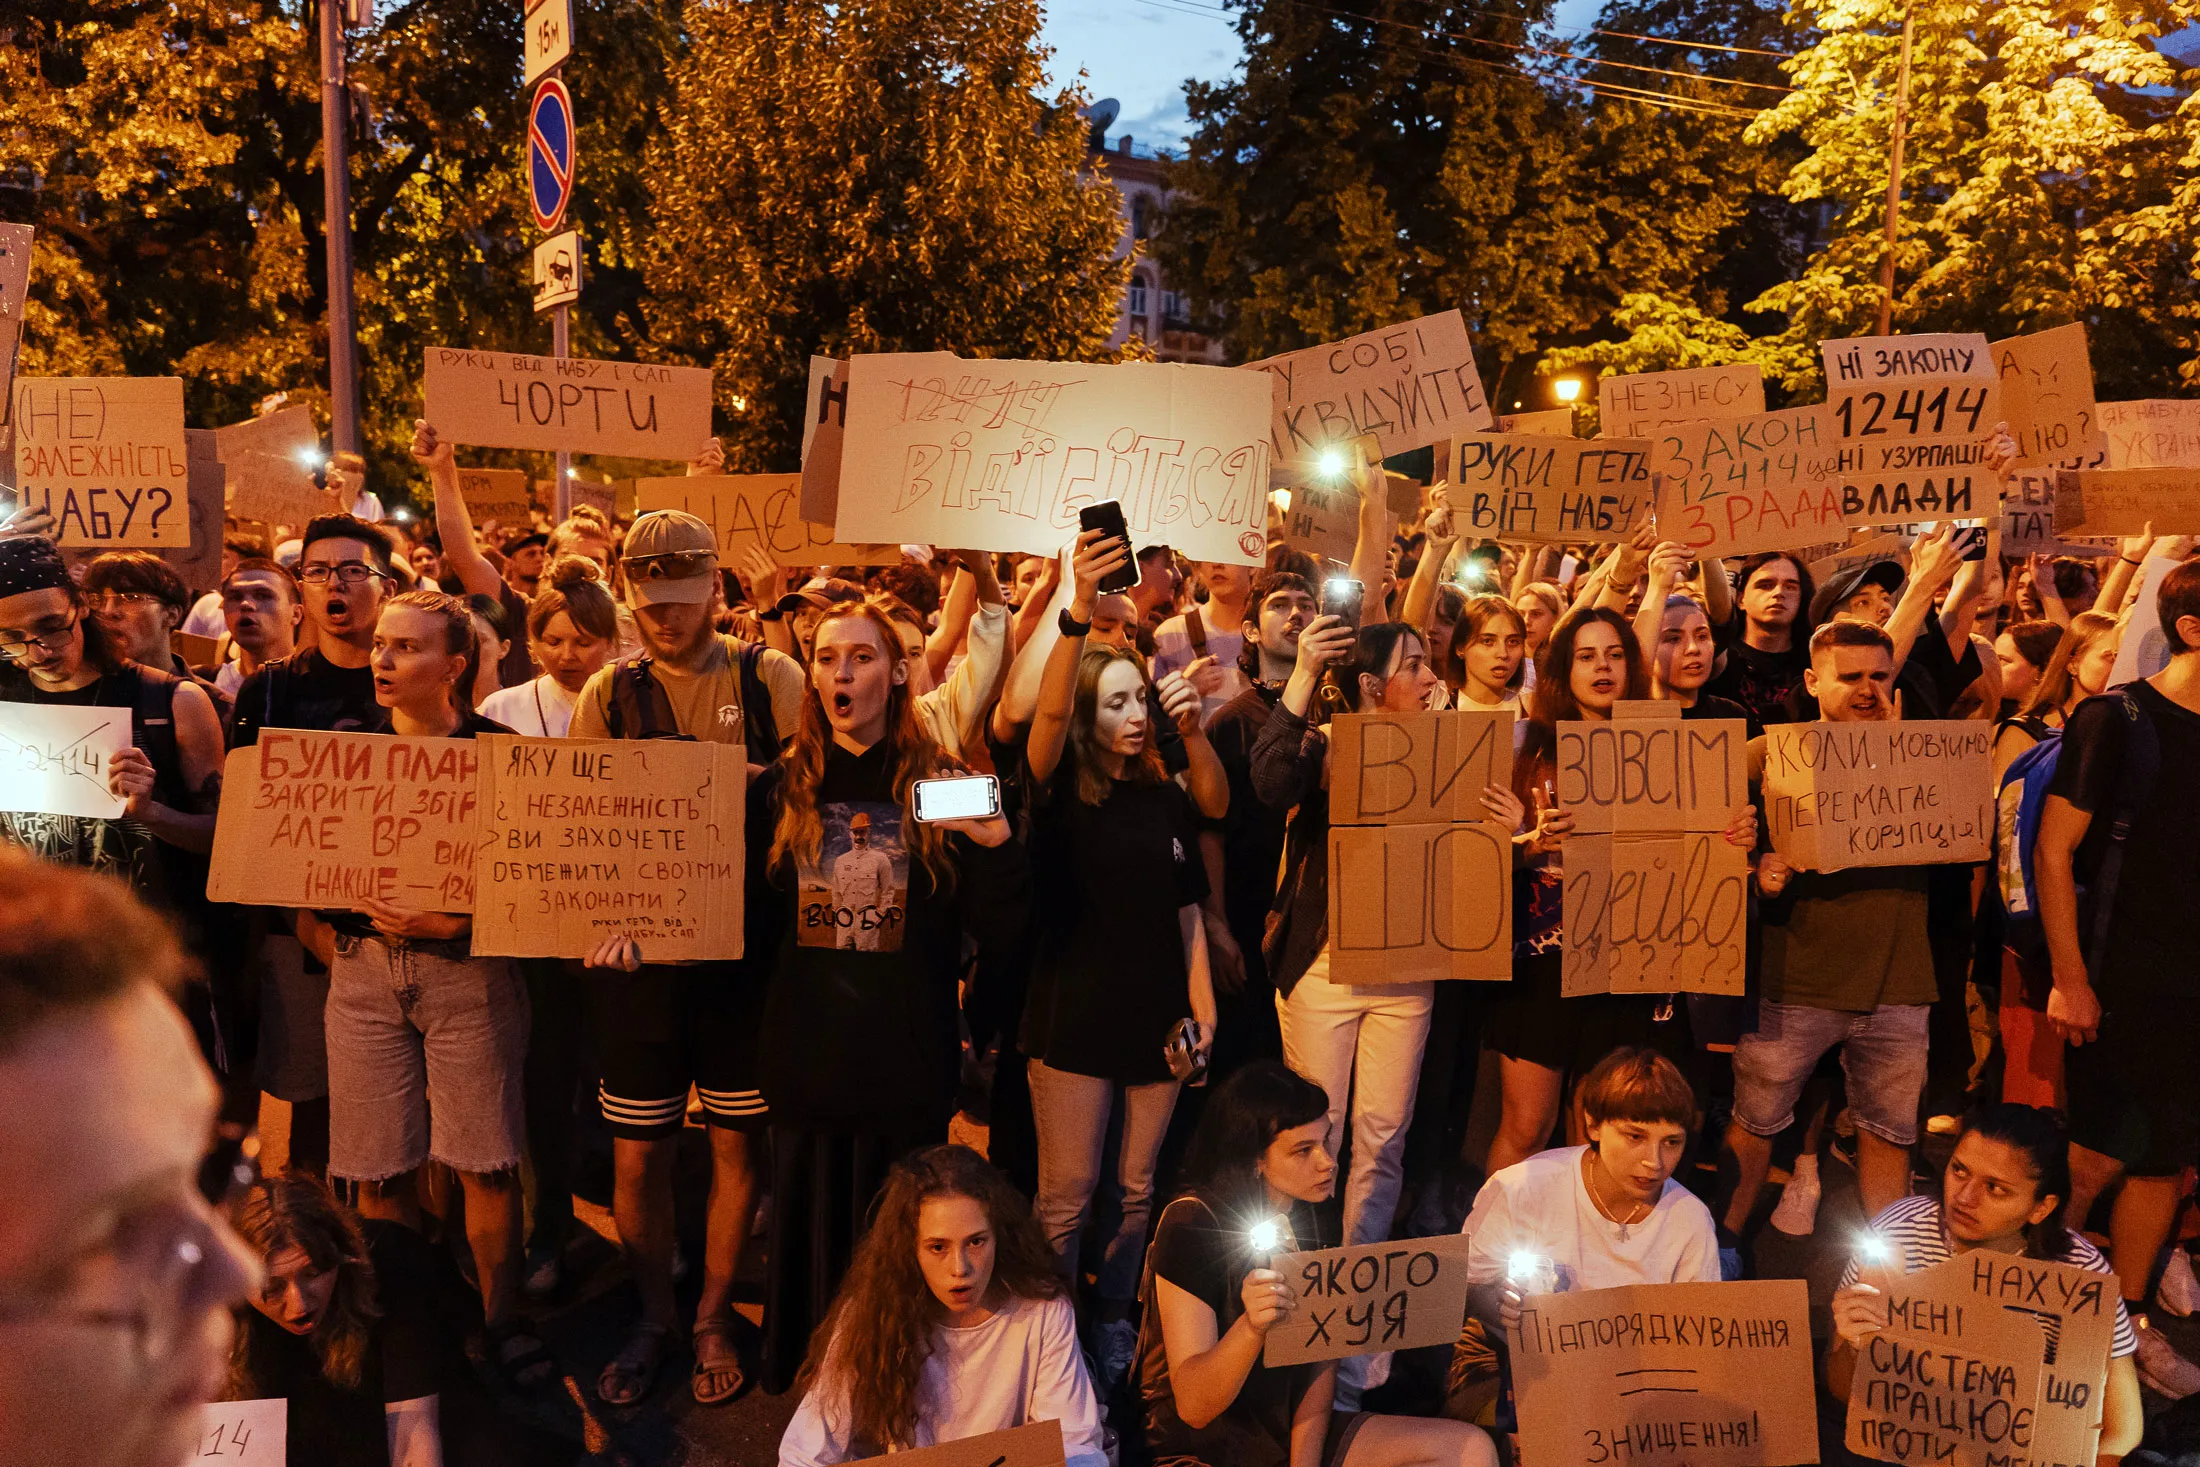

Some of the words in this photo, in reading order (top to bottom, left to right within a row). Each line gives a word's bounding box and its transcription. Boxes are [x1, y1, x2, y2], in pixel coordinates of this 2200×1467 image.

[439, 350, 495, 370] РУКИ
[513, 356, 541, 372] ВІД
[556, 358, 601, 378] НАБУ
[633, 365, 672, 383] САП
[1329, 328, 1427, 374] СОБІ
[1837, 346, 1864, 380] НІ
[1875, 347, 1974, 378] ЗАКОНУ
[19, 385, 106, 441] (НЕ)
[499, 379, 658, 433] ЧОРТИ
[1835, 386, 1988, 438] 12414
[21, 442, 186, 478] ЗАЛЕЖНІСТЬ
[1460, 441, 1555, 488] РУКИ
[1575, 451, 1649, 486] ГЕТЬ
[1663, 416, 1818, 480] ЗАКОН
[1838, 444, 1864, 472] НІ
[1679, 453, 1798, 505] 12414
[1842, 477, 1972, 515] ВЛАДИ
[24, 486, 173, 539] НАБУ?
[1472, 486, 1538, 532] ВІД
[1559, 492, 1636, 533] НАБУ
[1682, 486, 1843, 548] ЗРАДА
[260, 735, 372, 781] БУЛИ
[506, 746, 558, 778] ЯКУ
[572, 751, 614, 782] ЩЕ
[1357, 717, 1497, 819] ВИ
[1560, 728, 1731, 810] ЗОВСІМ
[1776, 730, 1872, 778] КОЛИ
[1889, 731, 1989, 766] МОВЧИМО
[254, 783, 396, 814] ЗАКРИТИ
[527, 793, 700, 820] НЕЗАЛЕЖНІСТЬ
[1775, 784, 1940, 836] ПЕРЕМАГАЄ
[270, 814, 344, 849] АЛЕ
[372, 815, 422, 857] ВР
[507, 829, 541, 849] ВИ
[559, 827, 686, 850] ЗАХОЧЕТЕ
[305, 861, 400, 901] ІНАКШЕ
[493, 861, 620, 882] ОБМЕЖИТИ
[639, 861, 731, 882] СВОЇМИ
[1336, 828, 1505, 952] ШО
[538, 889, 663, 914] ЗАКОНАМИ
[591, 919, 622, 927] РУКИ
[626, 917, 654, 925] ГЕТЬ
[670, 929, 695, 938] САП
[1302, 1251, 1439, 1298] ЯКОГО
[1973, 1257, 2104, 1315] НАХУЯ
[1305, 1290, 1409, 1348] ХУЯ
[1519, 1309, 1790, 1354] ПІДПОРЯДКУВАННЯ
[1887, 1296, 1964, 1337] МЕНІ
[1870, 1335, 2017, 1399] СИСТЕМА
[2046, 1374, 2091, 1410] ЩО
[1584, 1410, 1759, 1463] ЗНИЩЕННЯ!
[1866, 1380, 2034, 1448] ПРАЦЮЄ
[1861, 1420, 1958, 1466] ПРОТИ
